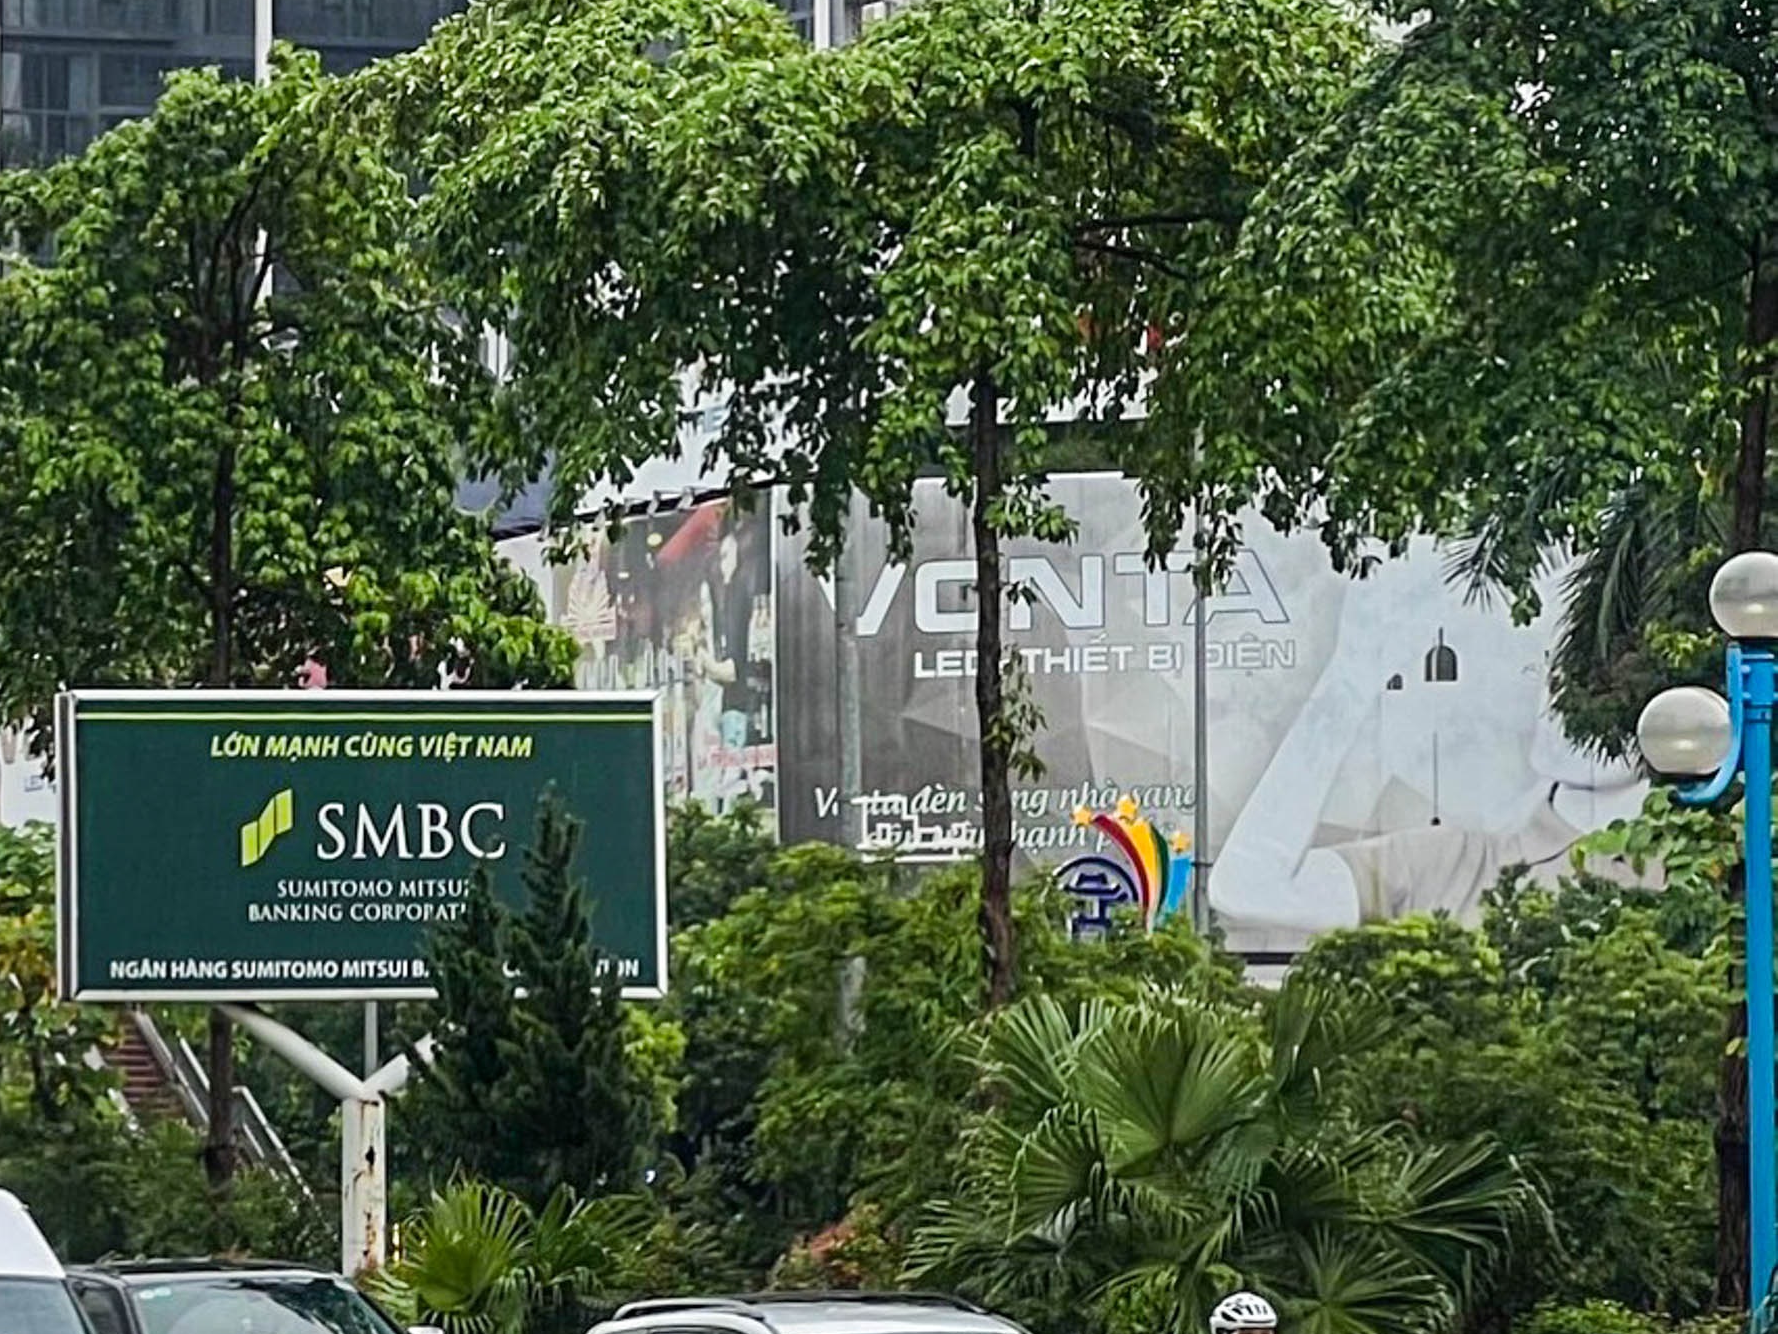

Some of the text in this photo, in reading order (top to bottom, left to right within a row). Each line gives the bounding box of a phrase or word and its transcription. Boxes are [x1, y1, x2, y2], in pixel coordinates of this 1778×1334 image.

[210, 730, 533, 762] LỚN MẠNH CÙNG VIỆT NAM
[315, 802, 506, 861] SMBC
[277, 879, 392, 899] SUMITOMO
[248, 902, 343, 922] BANKING
[110, 957, 168, 980] NGÂN
[170, 956, 228, 980] HÀNG
[230, 959, 340, 980] SUMITOMO
[342, 958, 409, 979] MITSUI
